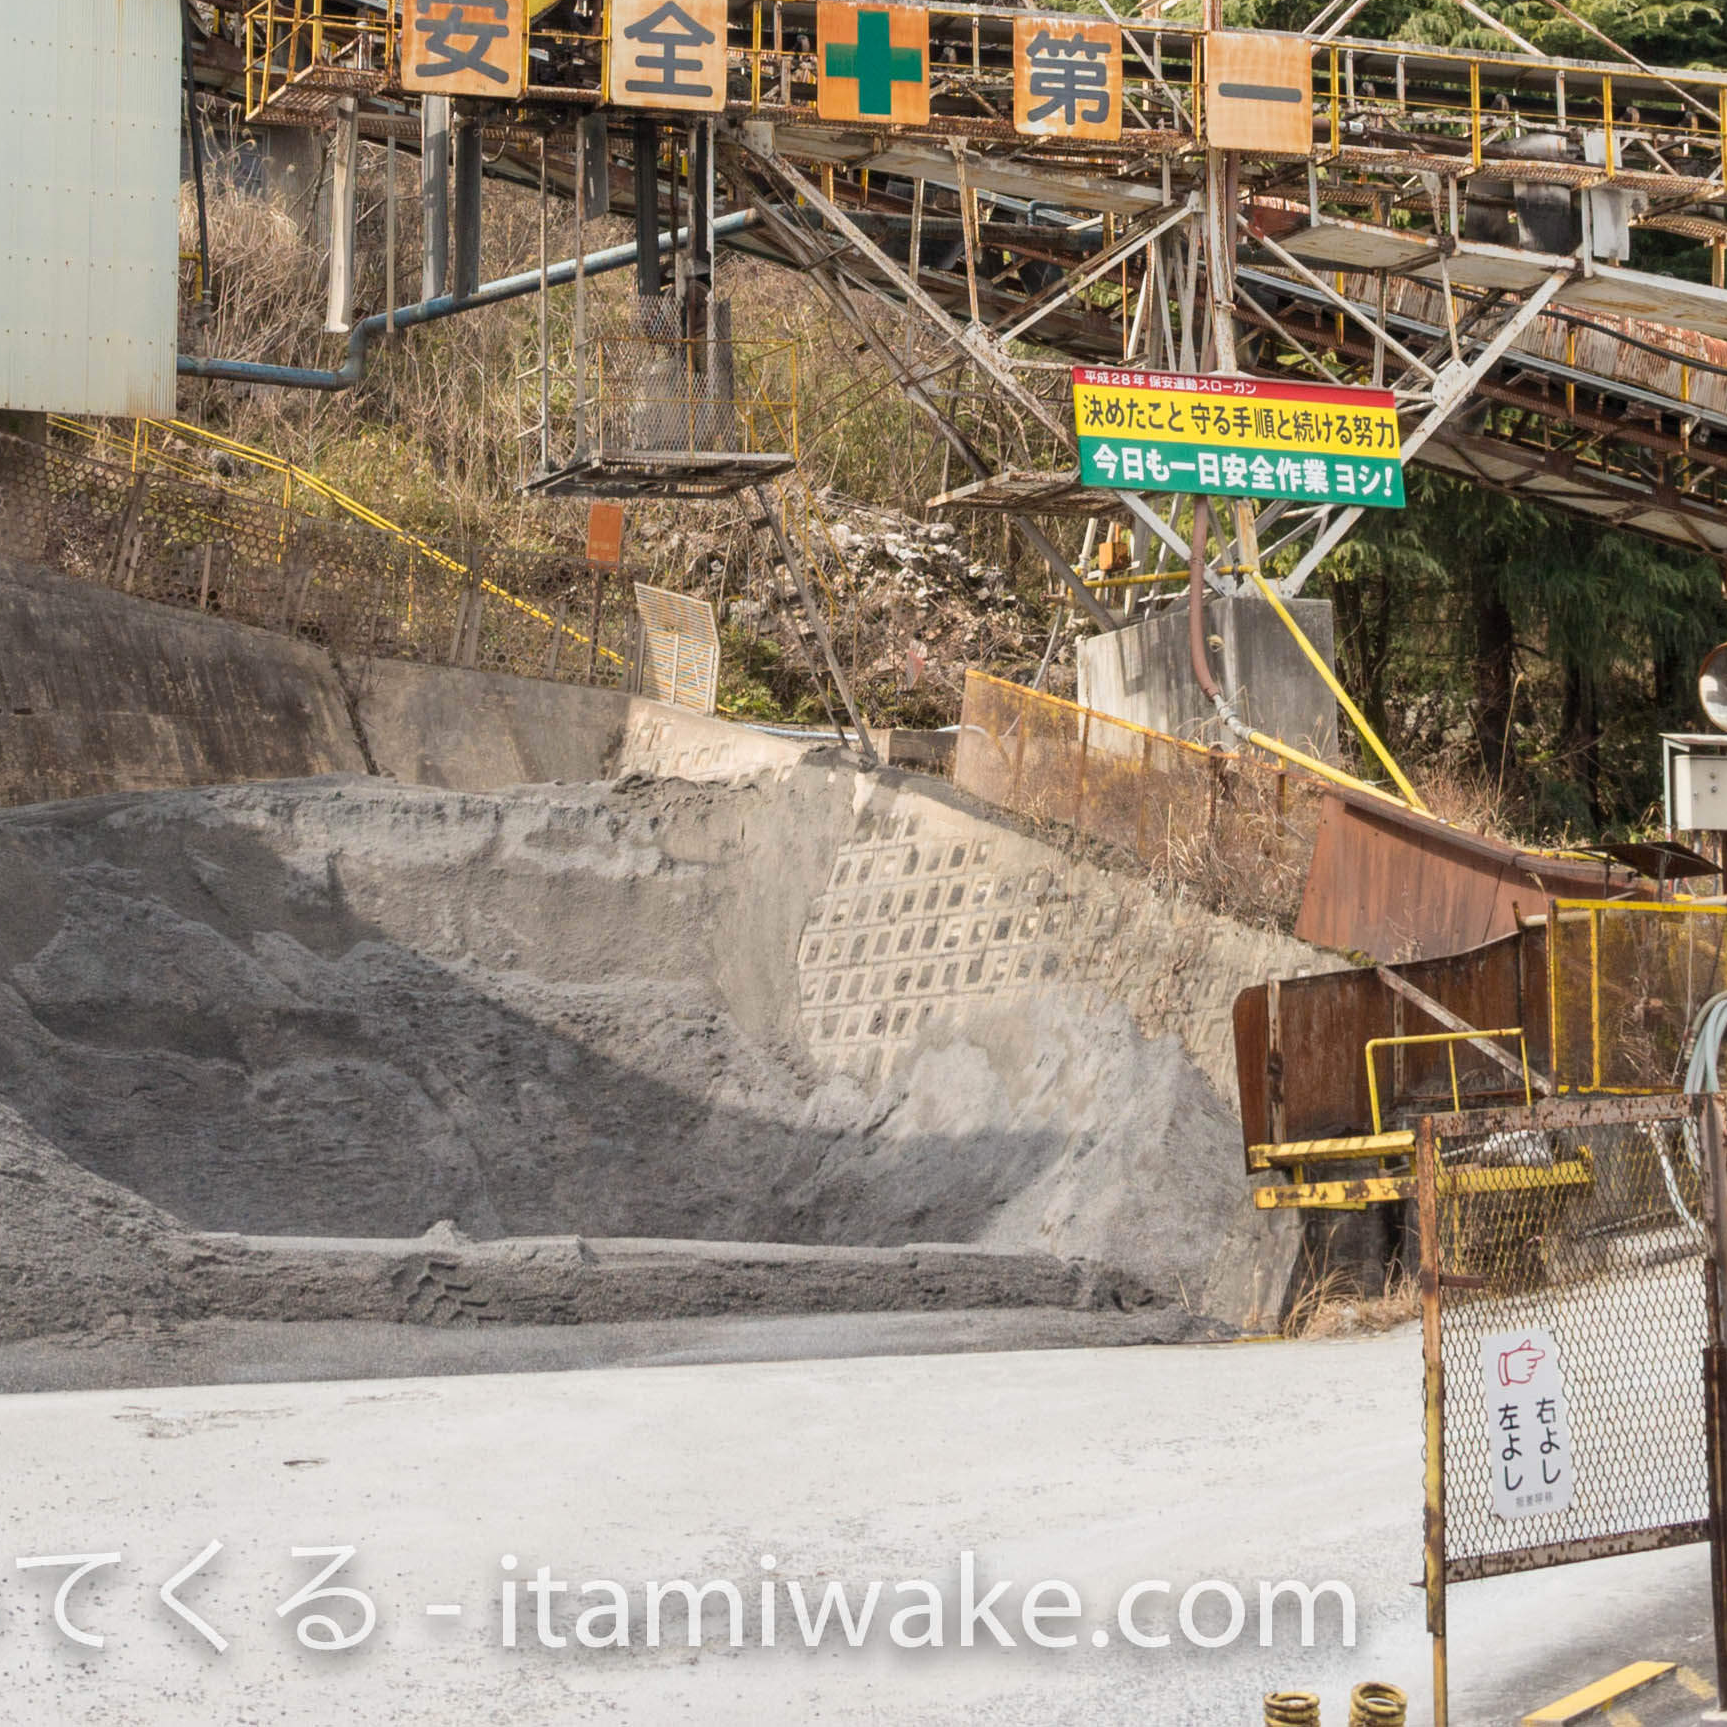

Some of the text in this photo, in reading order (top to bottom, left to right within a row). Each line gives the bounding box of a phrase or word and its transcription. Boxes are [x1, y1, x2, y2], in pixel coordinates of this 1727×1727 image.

[1084, 369, 1258, 395] 平成28年 保安運動スローガン
[1082, 393, 1396, 450] 決めたこと 守る手順と続ける努力
[1093, 444, 1330, 493] 今日も一日安全作業
[1498, 1404, 1523, 1491] 左よし
[1536, 1398, 1561, 1484] 右よし
